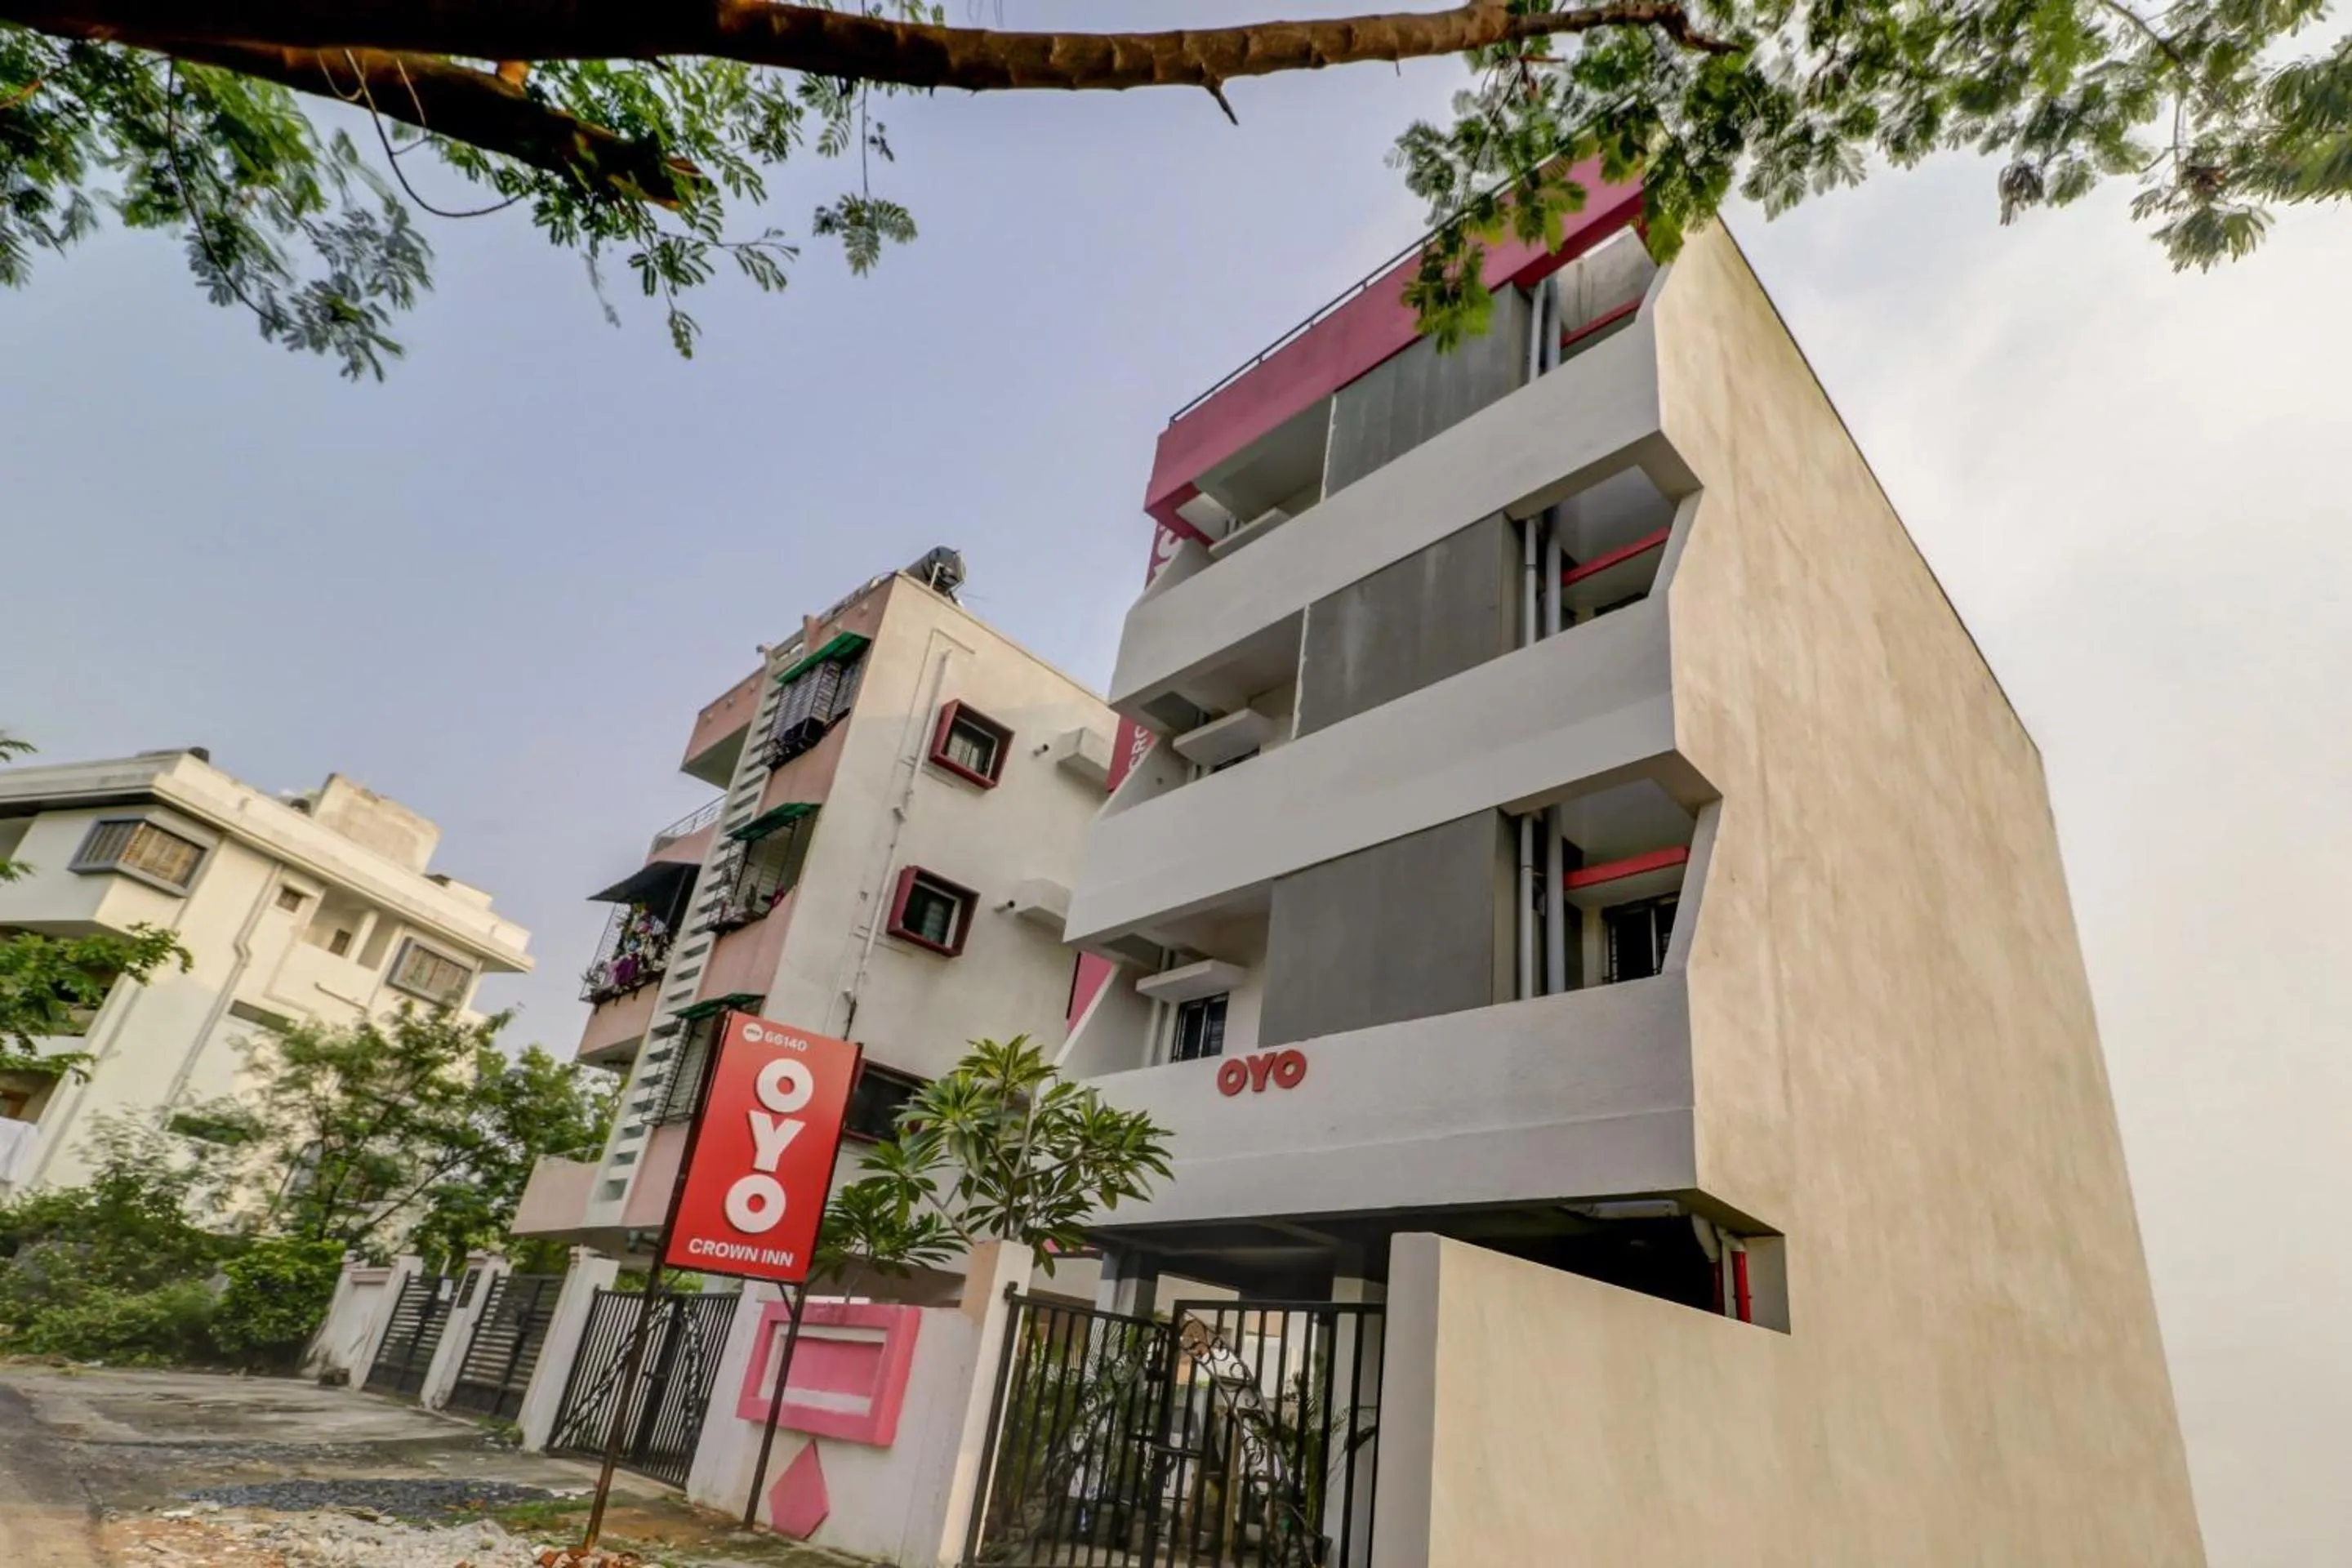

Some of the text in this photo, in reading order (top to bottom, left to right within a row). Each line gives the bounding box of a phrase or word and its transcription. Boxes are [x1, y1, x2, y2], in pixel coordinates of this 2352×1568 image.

[764, 1031, 808, 1052] 66140
[1217, 1049, 1307, 1097] OYO
[725, 1058, 813, 1233] OYO
[688, 1238, 795, 1267] CROWN INN
